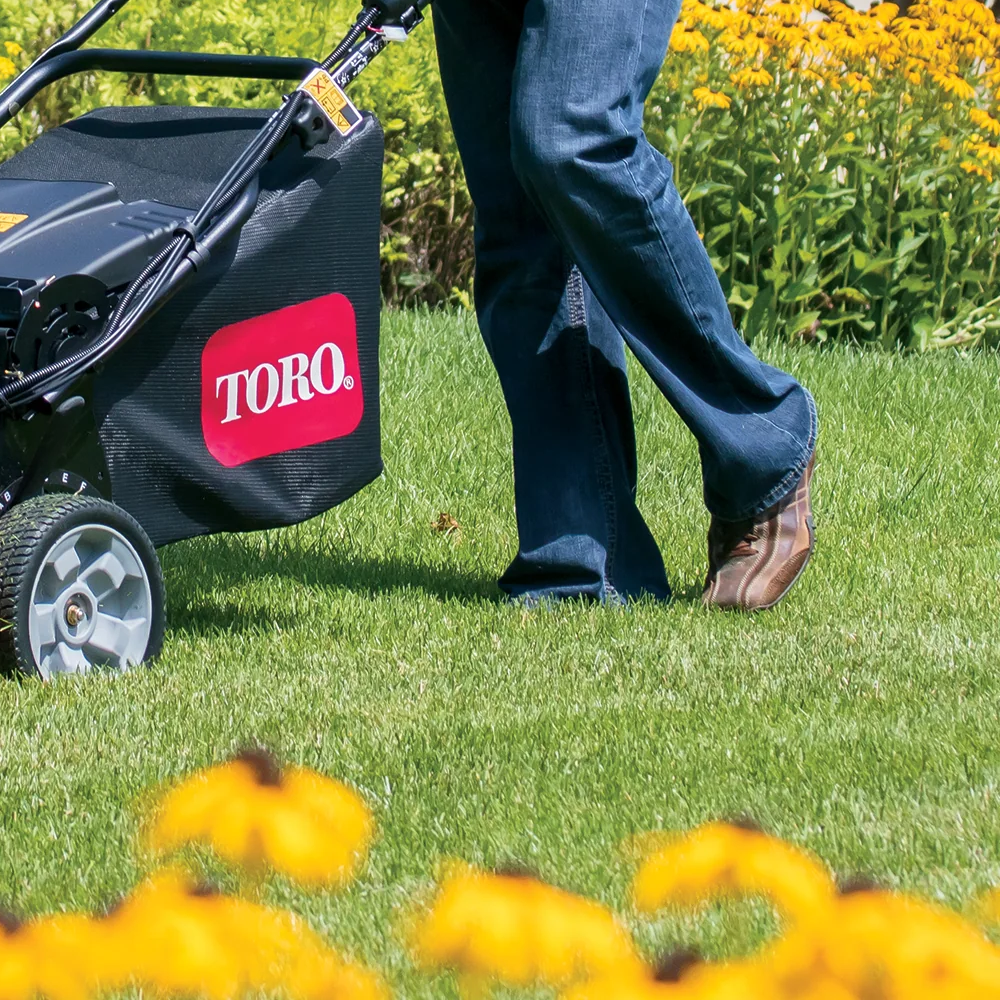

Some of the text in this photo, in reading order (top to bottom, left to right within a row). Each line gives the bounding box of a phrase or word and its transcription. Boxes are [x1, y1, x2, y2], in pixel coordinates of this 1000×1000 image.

[4, 491, 10, 501] B
[62, 472, 69, 483] E
[80, 481, 86, 490] F
